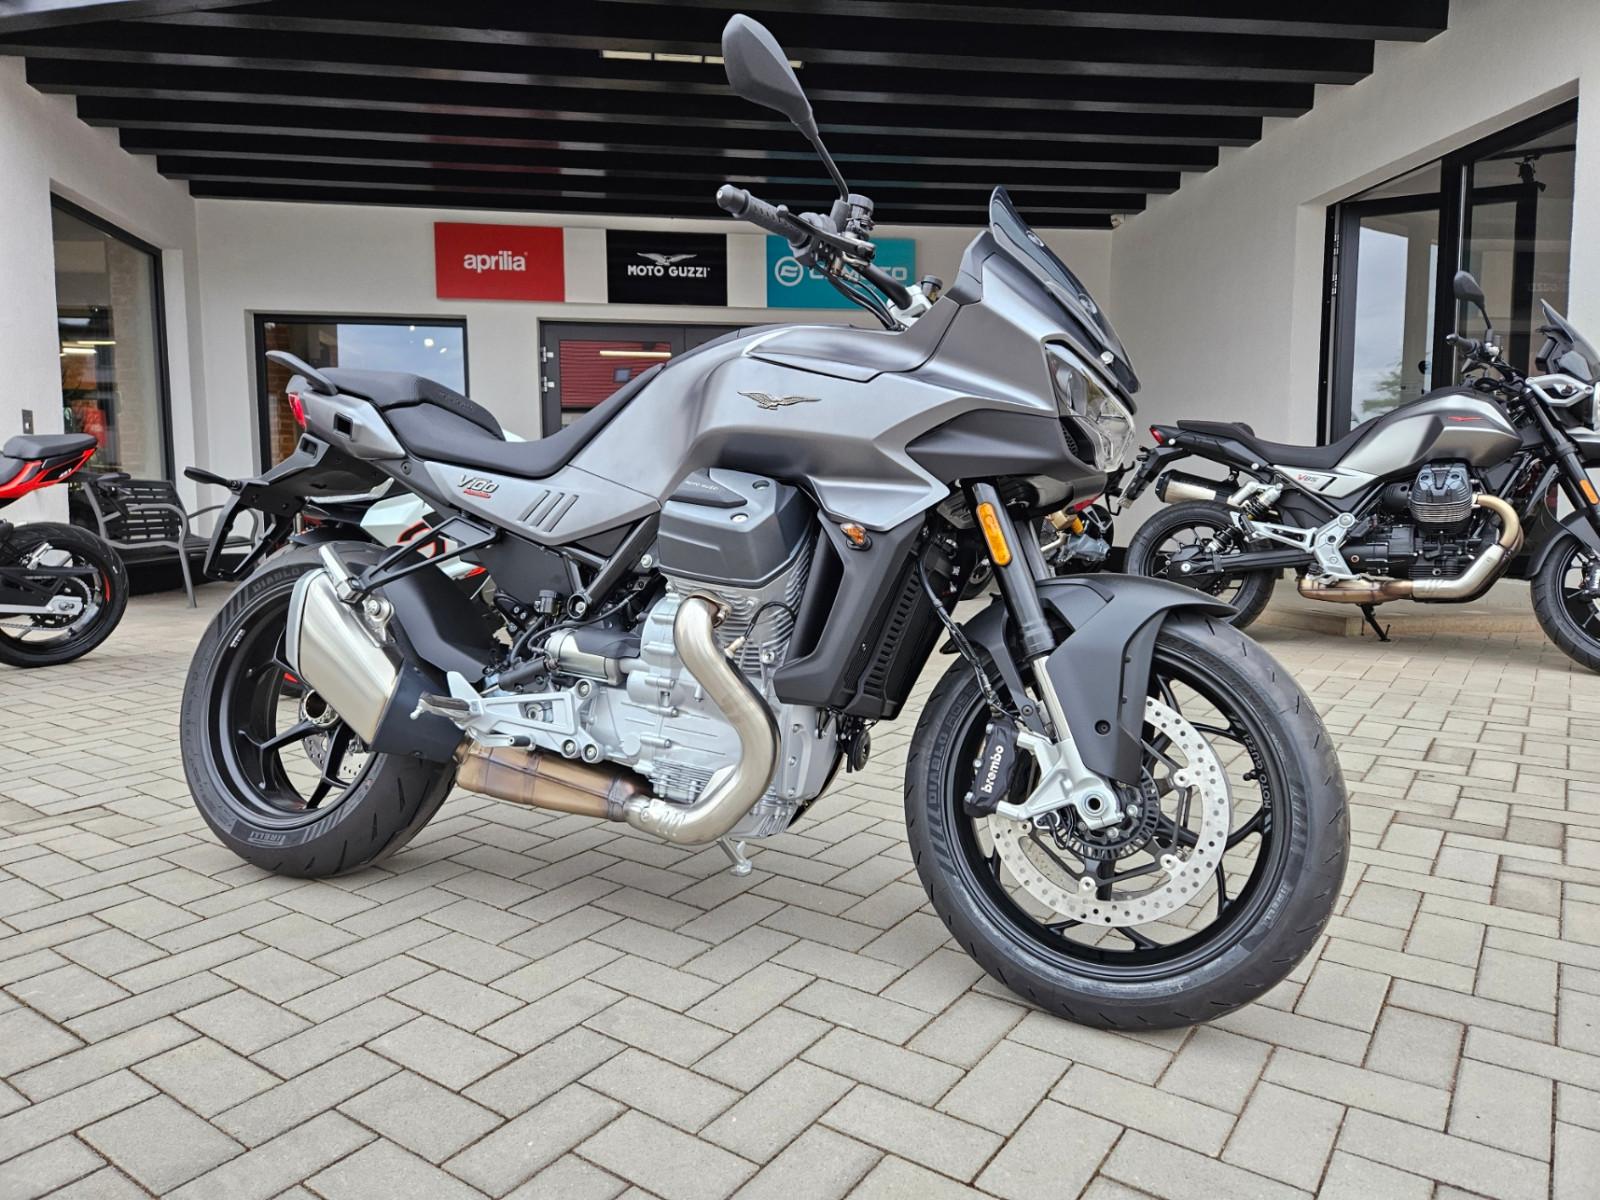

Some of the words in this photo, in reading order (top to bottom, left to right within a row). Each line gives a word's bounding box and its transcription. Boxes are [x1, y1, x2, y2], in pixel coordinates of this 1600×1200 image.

[463, 250, 526, 274] aprilia
[627, 265, 664, 277] MOTO
[668, 266, 707, 278] GUZZI
[457, 474, 500, 493] V100
[1242, 733, 1263, 770] GUZZI
[980, 745, 1004, 793] brembo
[1259, 773, 1272, 809] MOTO
